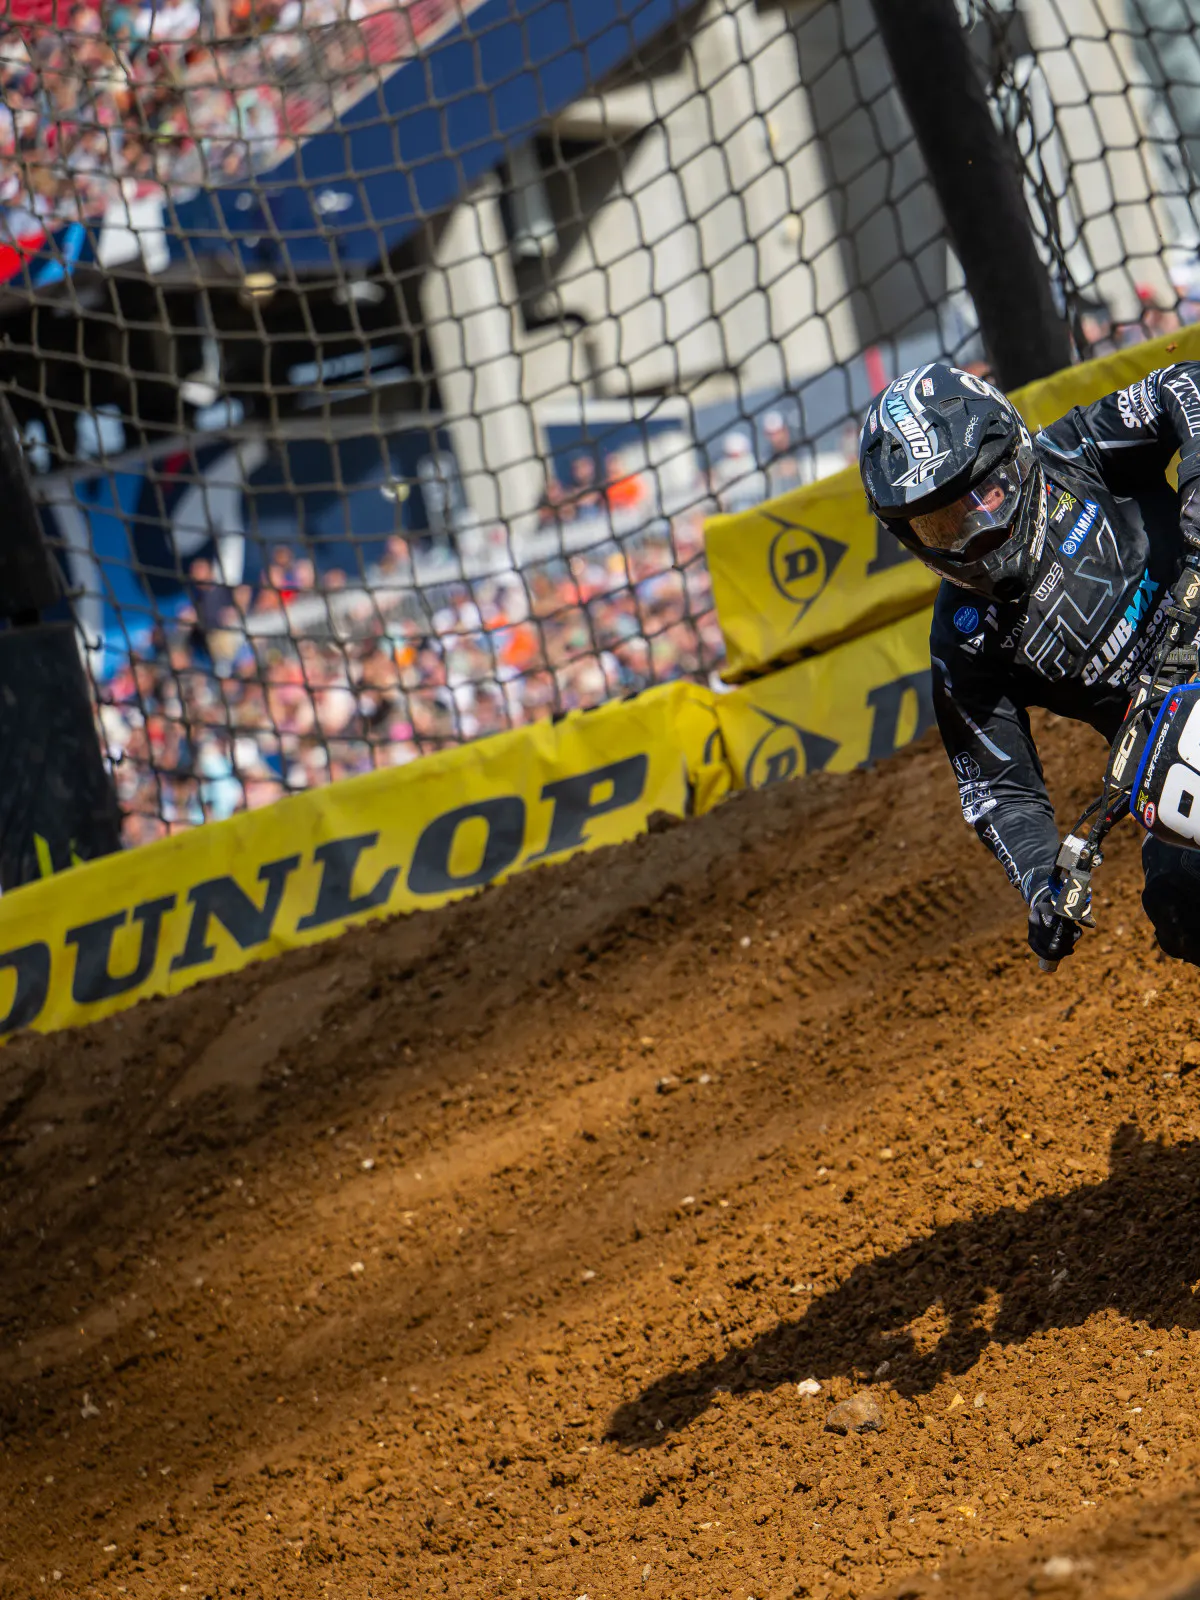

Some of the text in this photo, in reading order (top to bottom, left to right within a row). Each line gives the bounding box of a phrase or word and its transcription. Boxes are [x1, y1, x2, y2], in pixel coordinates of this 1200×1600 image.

[887, 394, 933, 460] CLUBMX
[1054, 491, 1078, 524] SMX
[1068, 502, 1100, 545] YAMAHA
[1035, 562, 1064, 602] WPS
[1081, 568, 1160, 686] CLUBMX
[1169, 621, 1180, 641] ASV
[1143, 722, 1170, 788] SUPERCROSS
[1063, 878, 1083, 918] ASV
